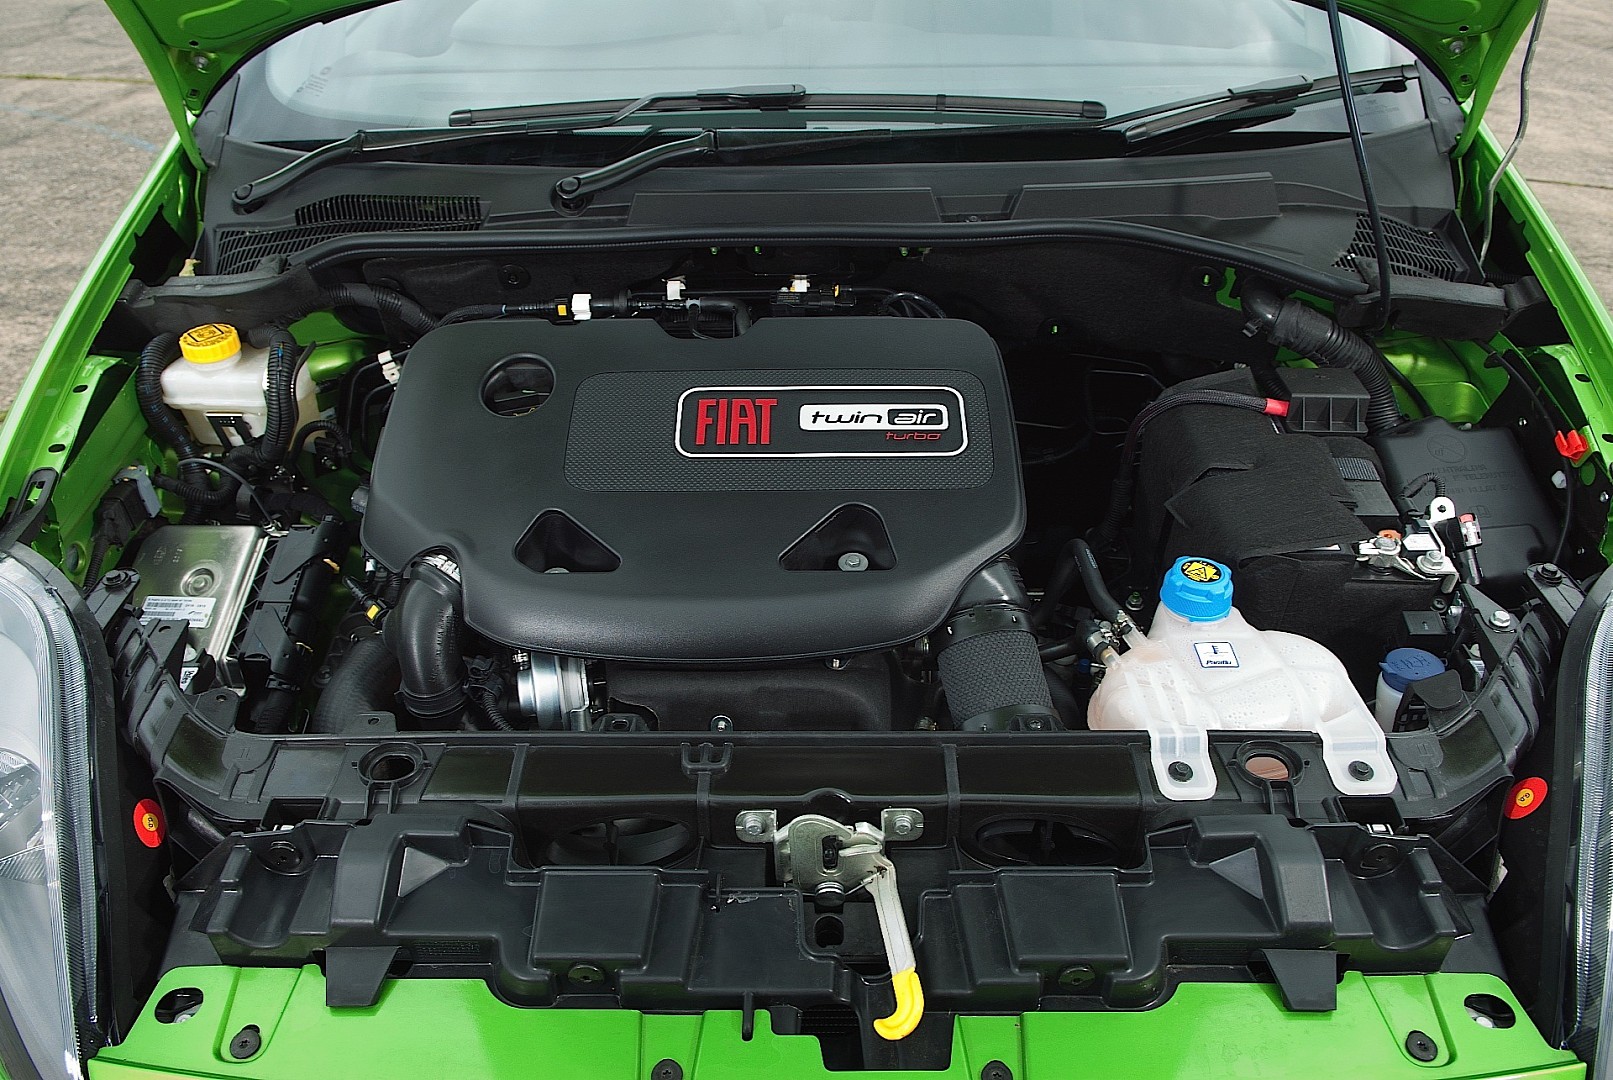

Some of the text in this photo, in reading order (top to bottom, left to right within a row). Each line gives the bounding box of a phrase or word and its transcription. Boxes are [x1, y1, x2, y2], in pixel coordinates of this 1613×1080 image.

[696, 398, 778, 445] FIAT
[811, 410, 937, 425] twin air
[885, 431, 941, 440] turbo
